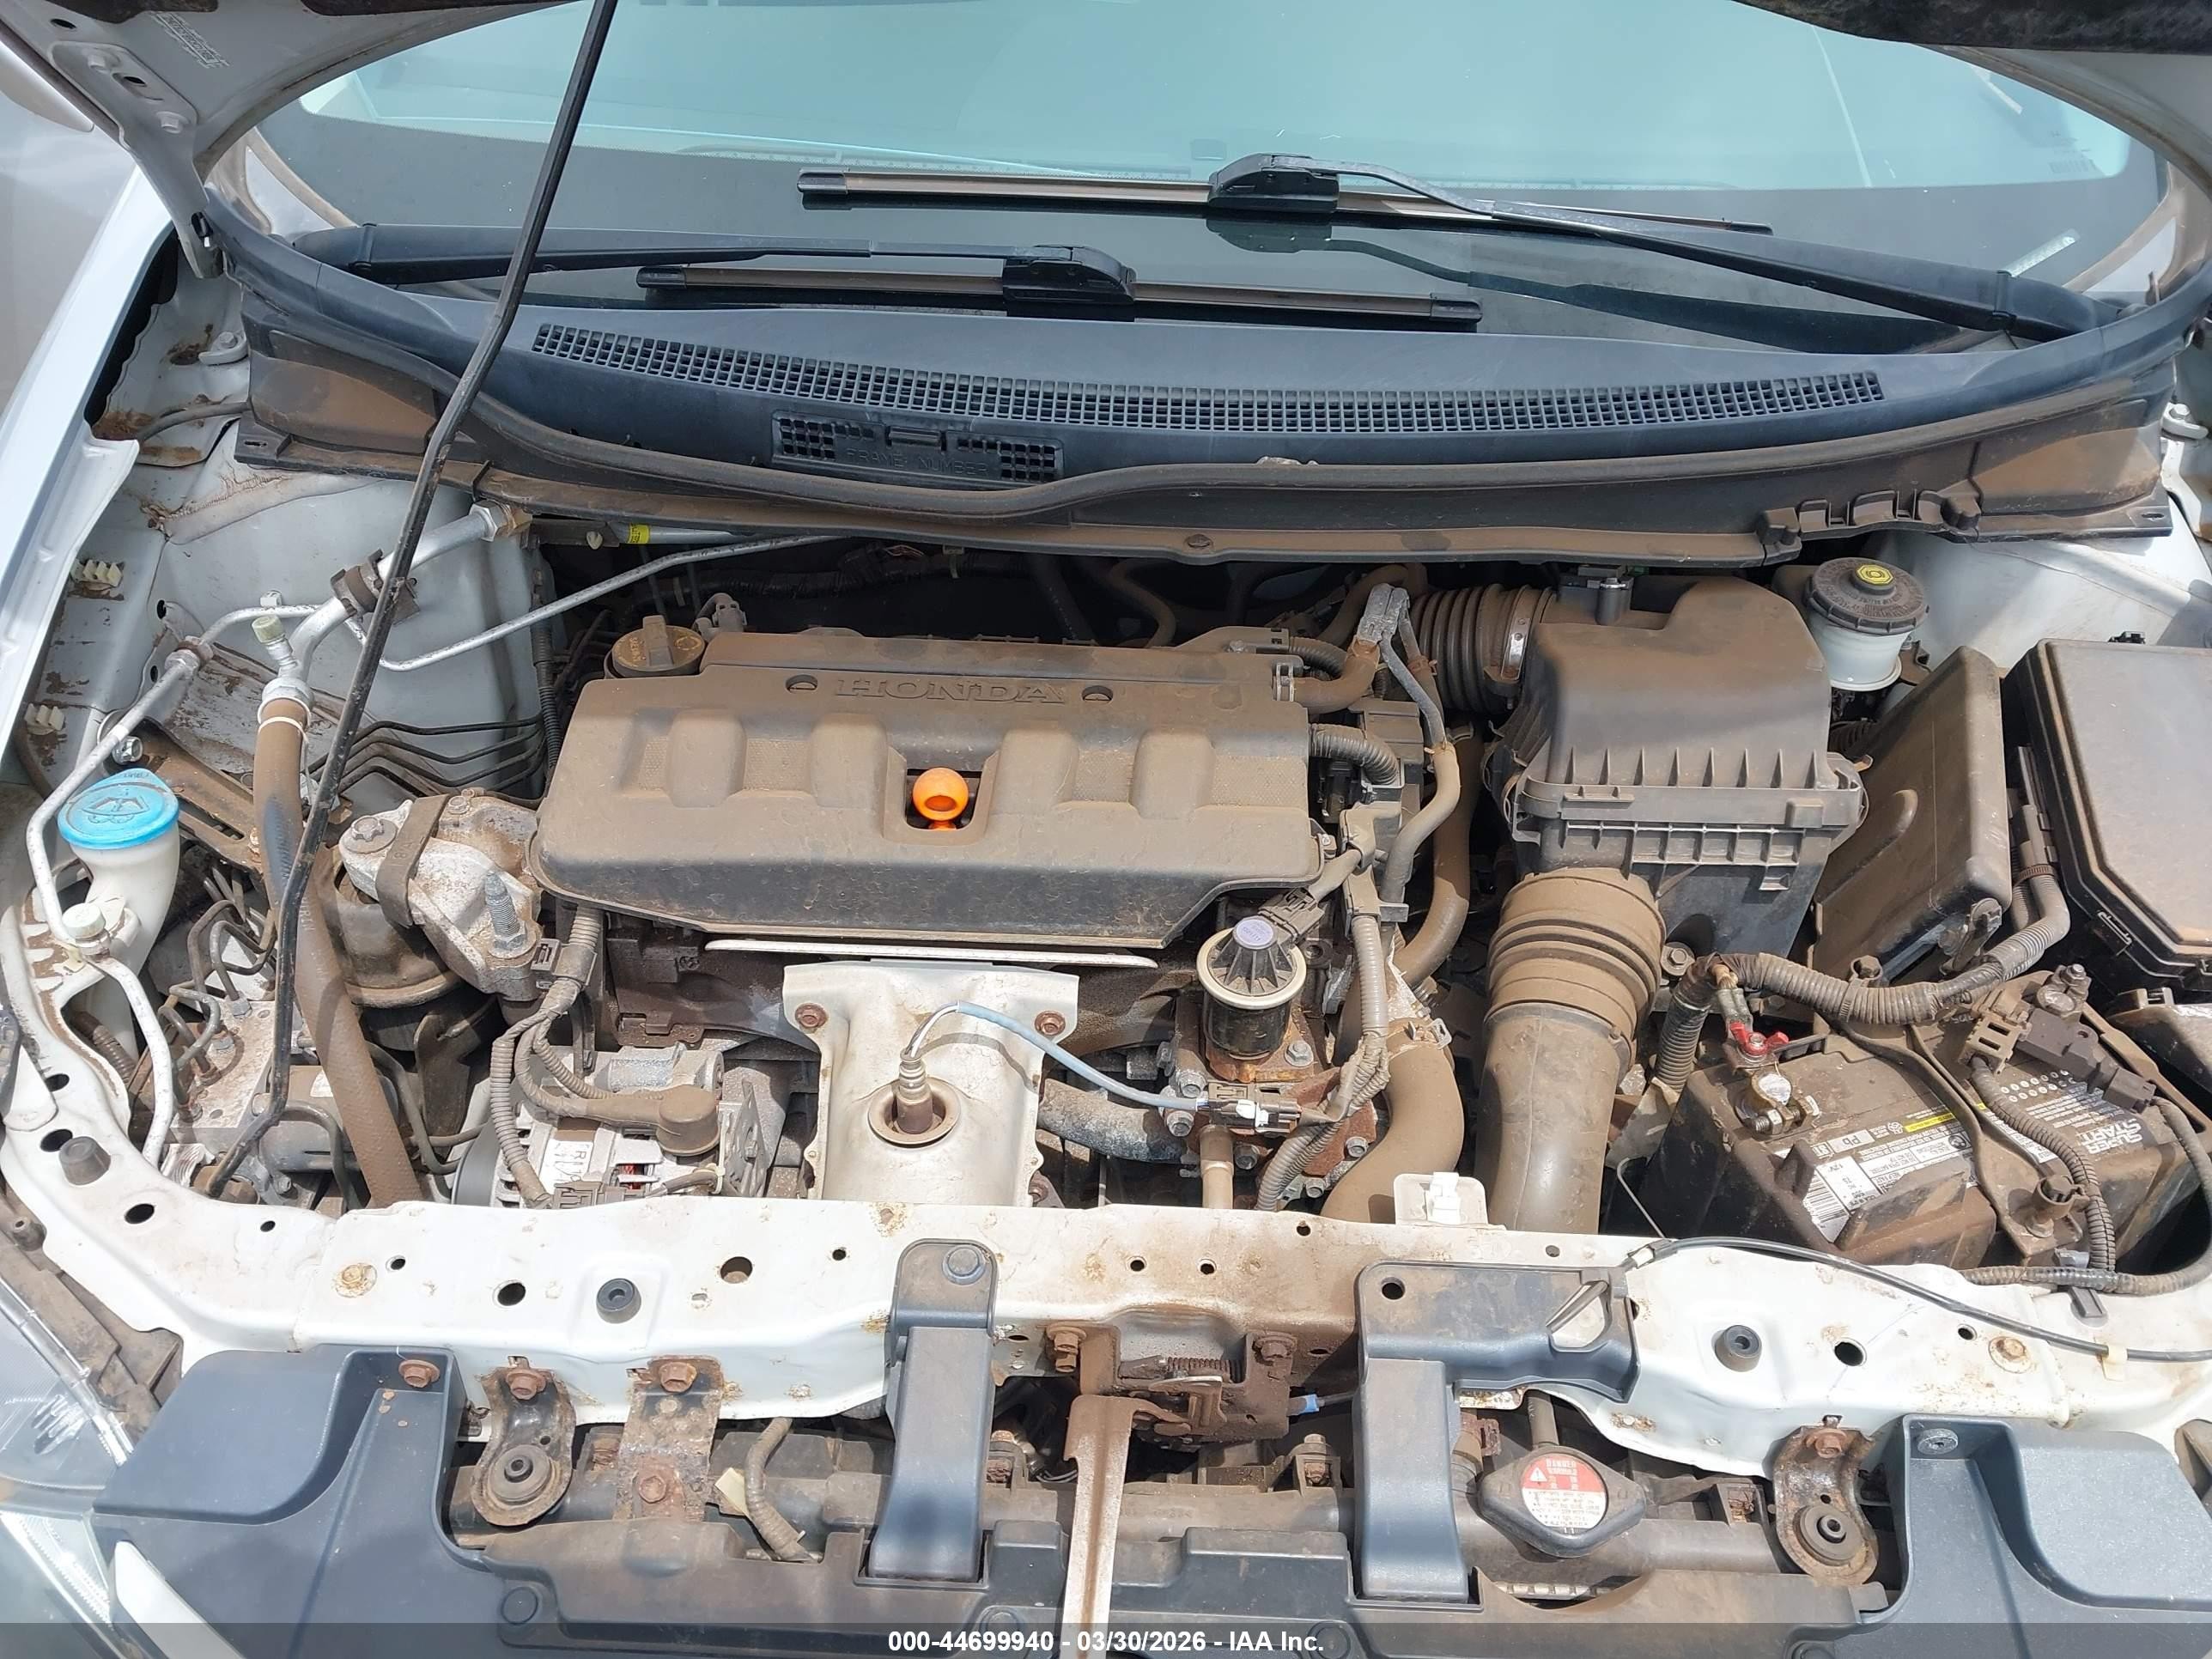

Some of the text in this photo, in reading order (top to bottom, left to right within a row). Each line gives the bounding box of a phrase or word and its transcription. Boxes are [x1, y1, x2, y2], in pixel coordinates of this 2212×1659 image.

[847, 447, 988, 475] FRAME NUMBER
[836, 679, 1066, 703] HONDA
[1842, 1134, 1861, 1146] Pb
[2080, 1118, 2142, 1146] START
[2086, 1133, 2143, 1154] SUPER
